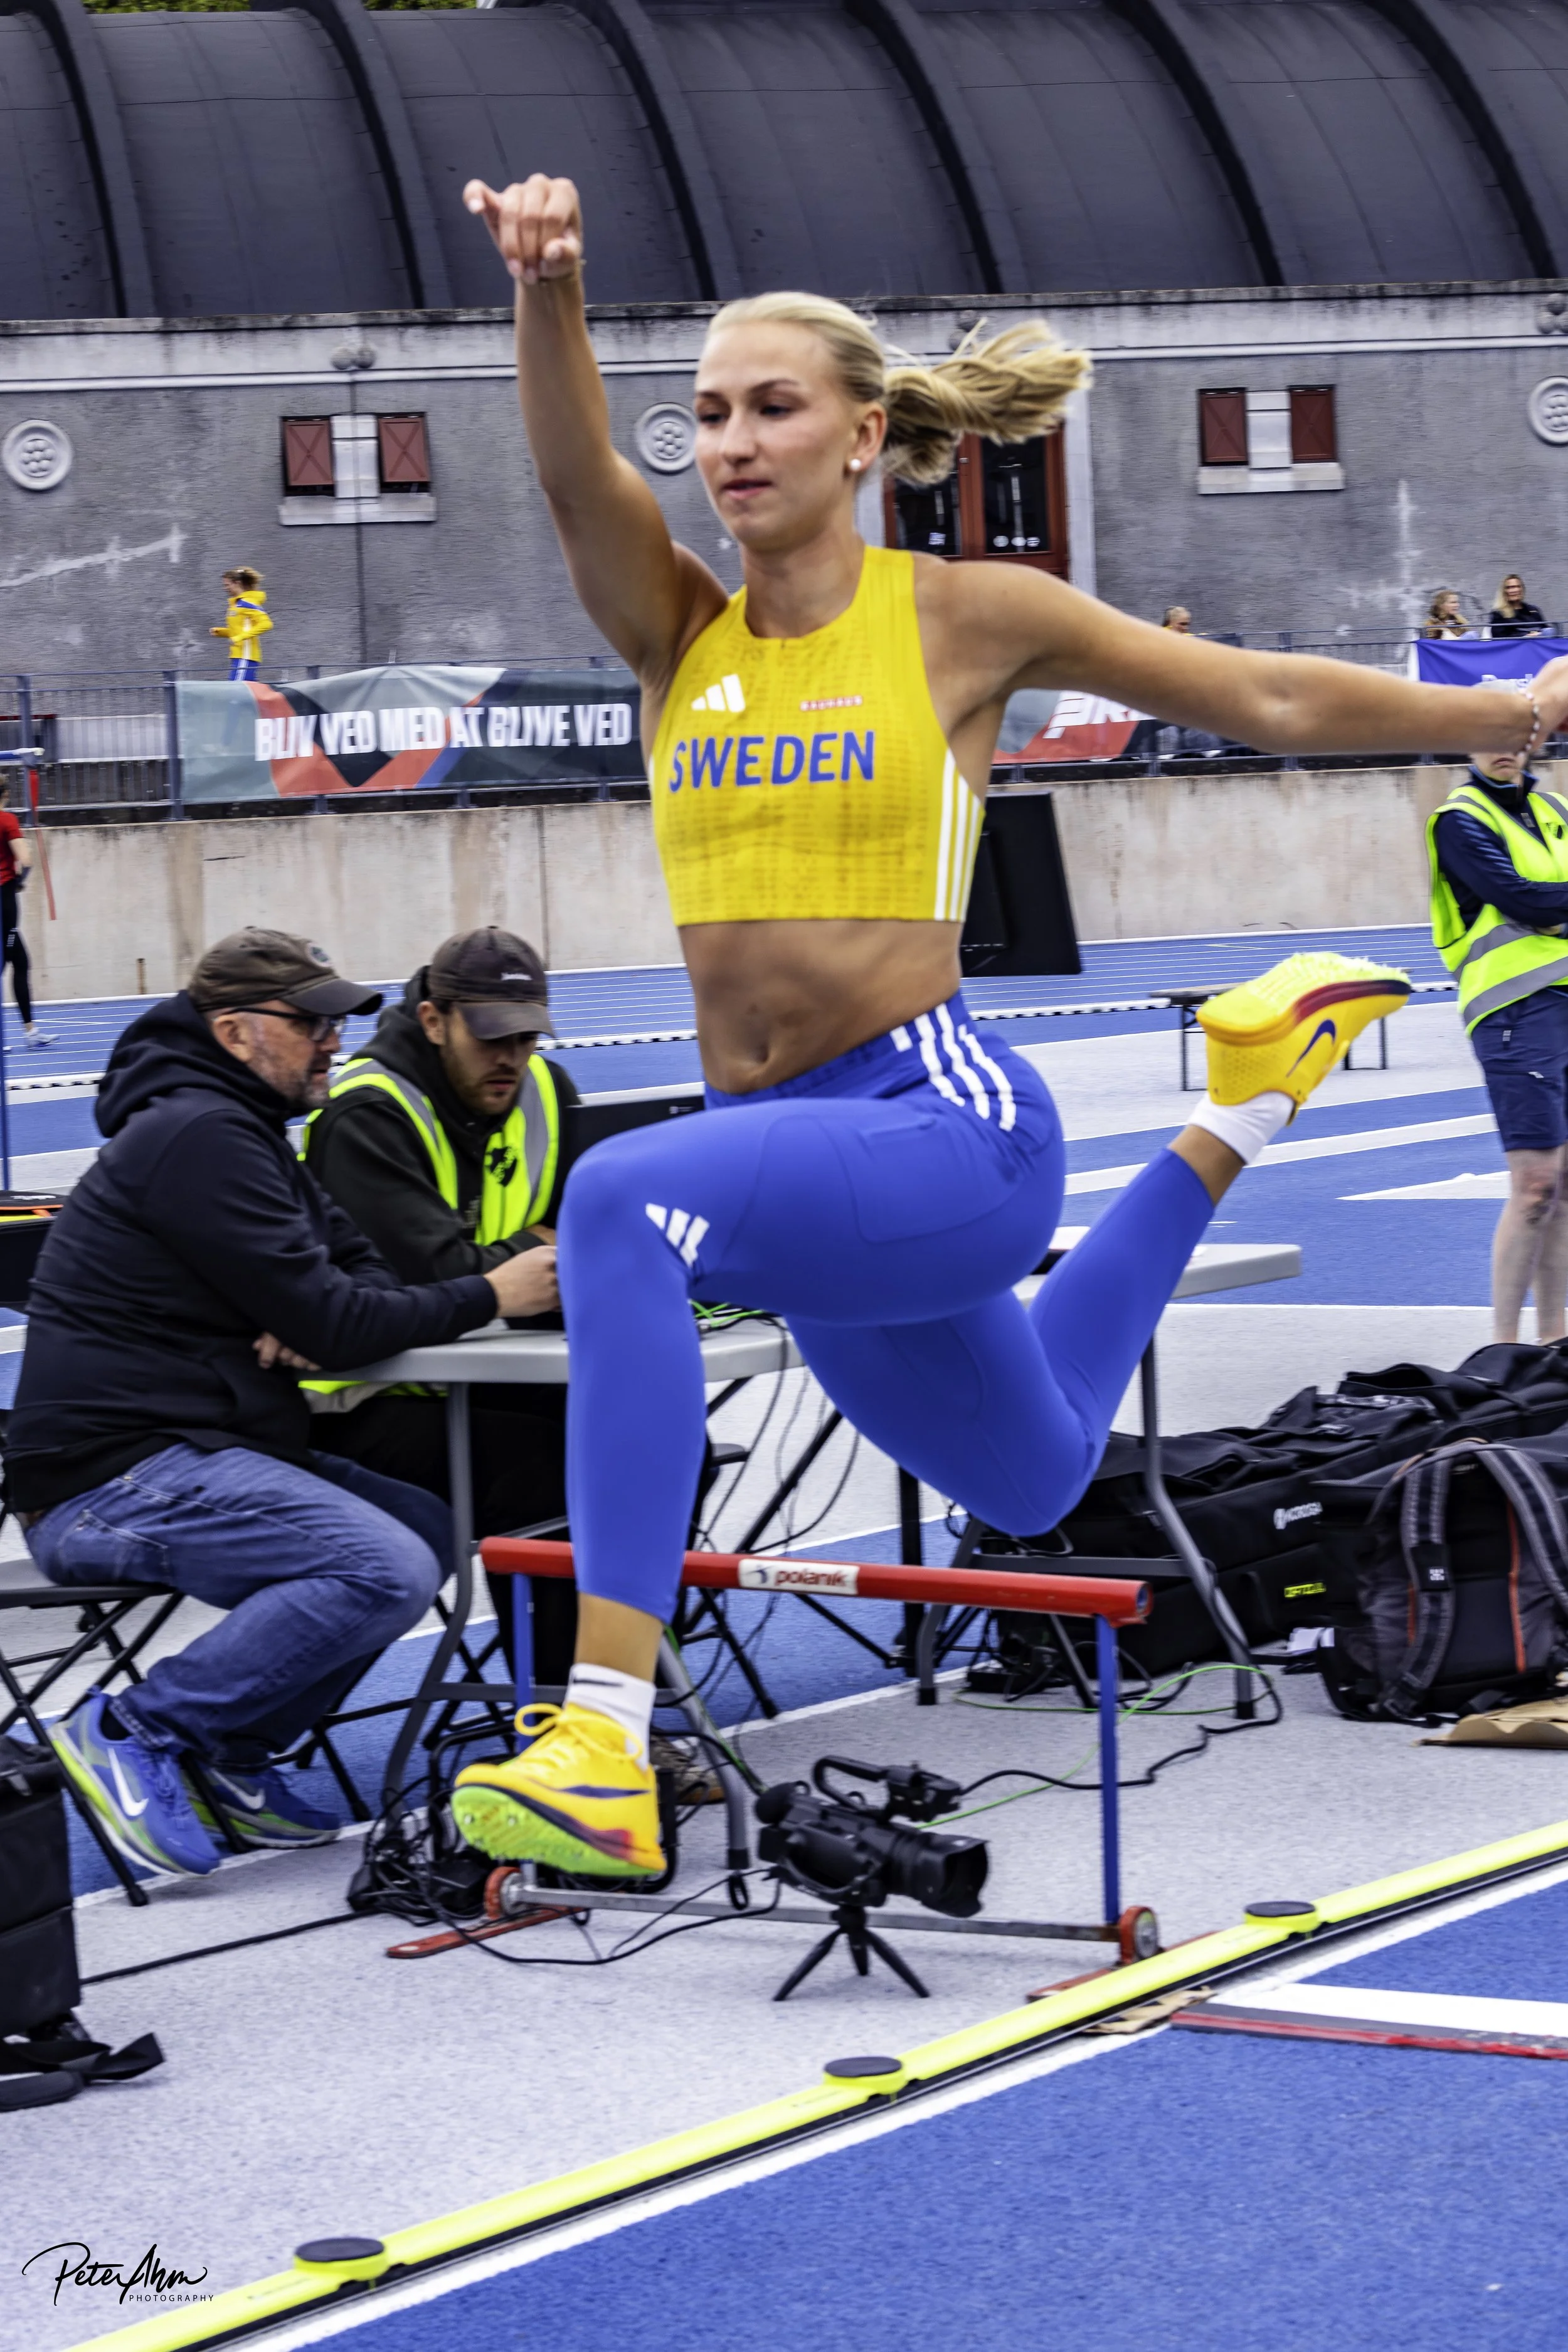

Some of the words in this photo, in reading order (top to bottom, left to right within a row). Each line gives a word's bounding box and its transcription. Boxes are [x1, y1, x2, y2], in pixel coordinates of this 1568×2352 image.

[254, 714, 319, 761] BLIV
[319, 710, 377, 756] VED
[378, 706, 446, 752] MED
[449, 706, 485, 748] AT
[487, 705, 571, 748] BLIVE
[573, 703, 633, 746] VED
[669, 730, 875, 794] SWEDEN
[775, 1567, 847, 1587] polanik
